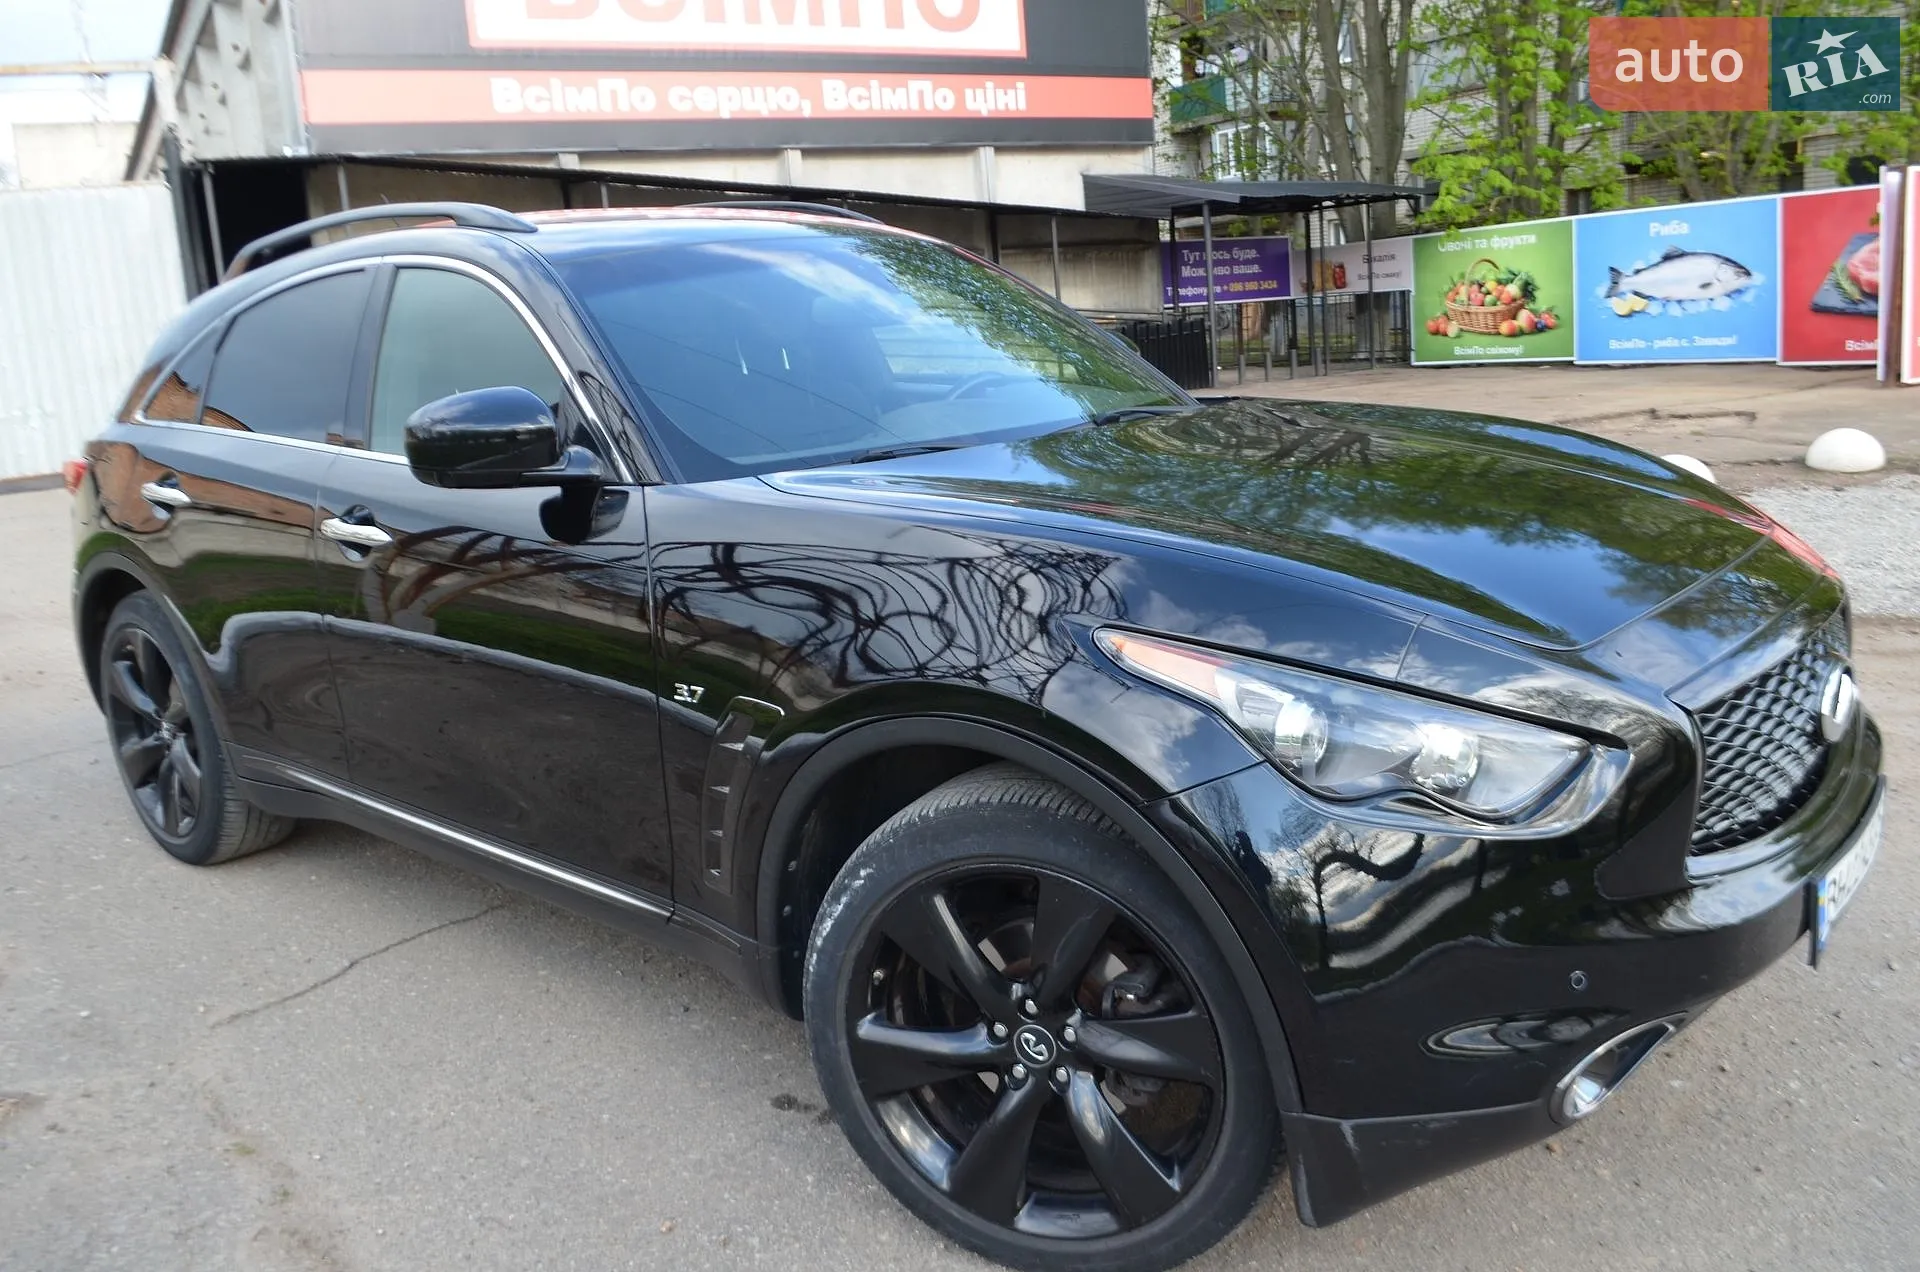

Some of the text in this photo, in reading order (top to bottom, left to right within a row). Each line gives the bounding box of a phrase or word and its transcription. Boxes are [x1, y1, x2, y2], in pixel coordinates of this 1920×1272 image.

[489, 77, 1027, 118] ВсімПо серцю, ВсімПо ціні
[1649, 220, 1689, 237] Риба
[1474, 238, 1487, 249] та
[1490, 234, 1536, 250] фрукти
[1182, 249, 1201, 264] Тут
